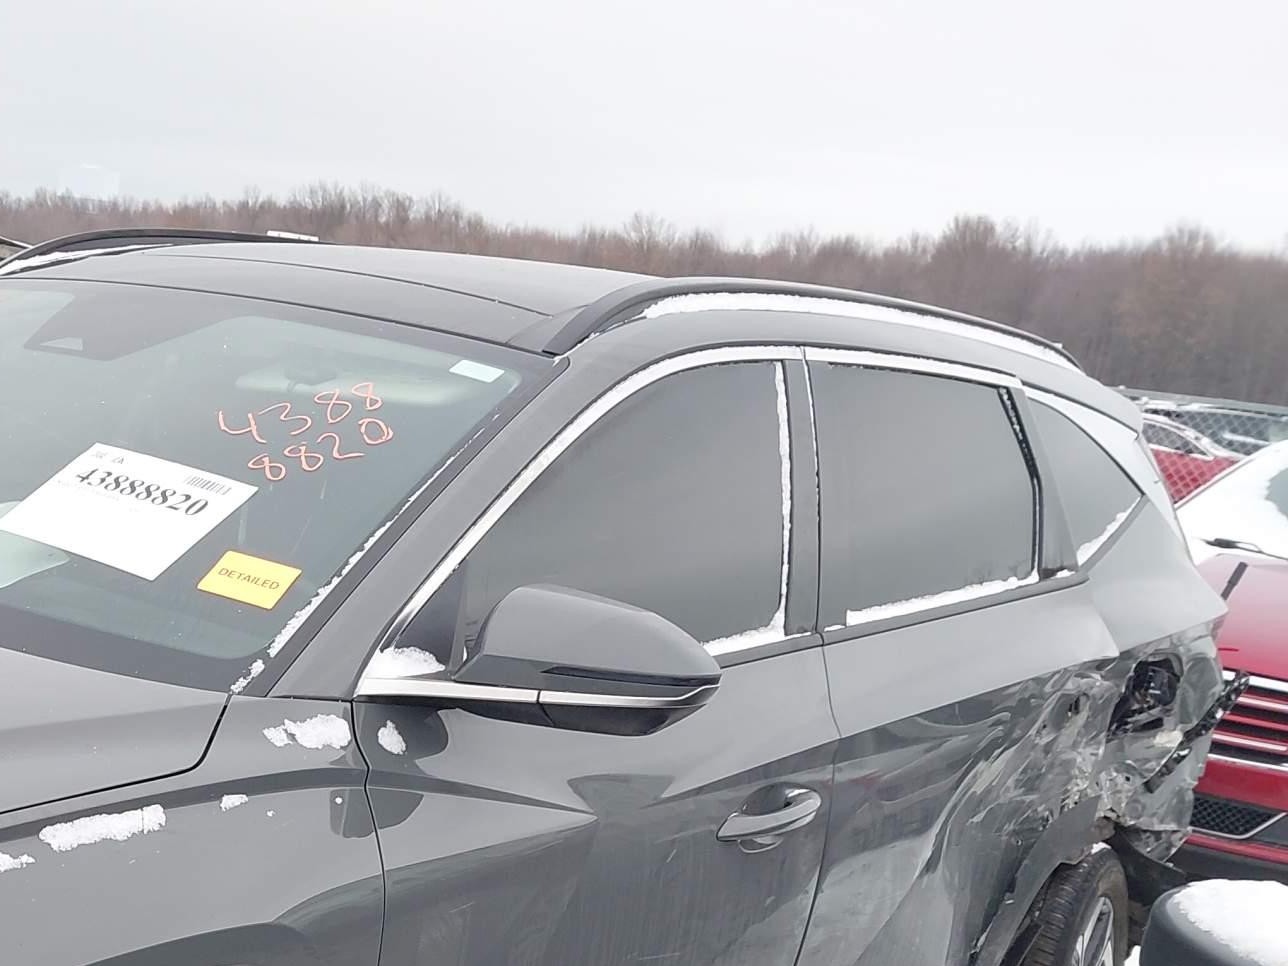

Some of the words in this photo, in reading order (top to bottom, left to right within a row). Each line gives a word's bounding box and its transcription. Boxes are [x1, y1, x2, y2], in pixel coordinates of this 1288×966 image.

[217, 381, 383, 444] 4388
[247, 417, 394, 481] 8820
[75, 467, 209, 516] 43888820
[217, 567, 280, 590] DETAILED
